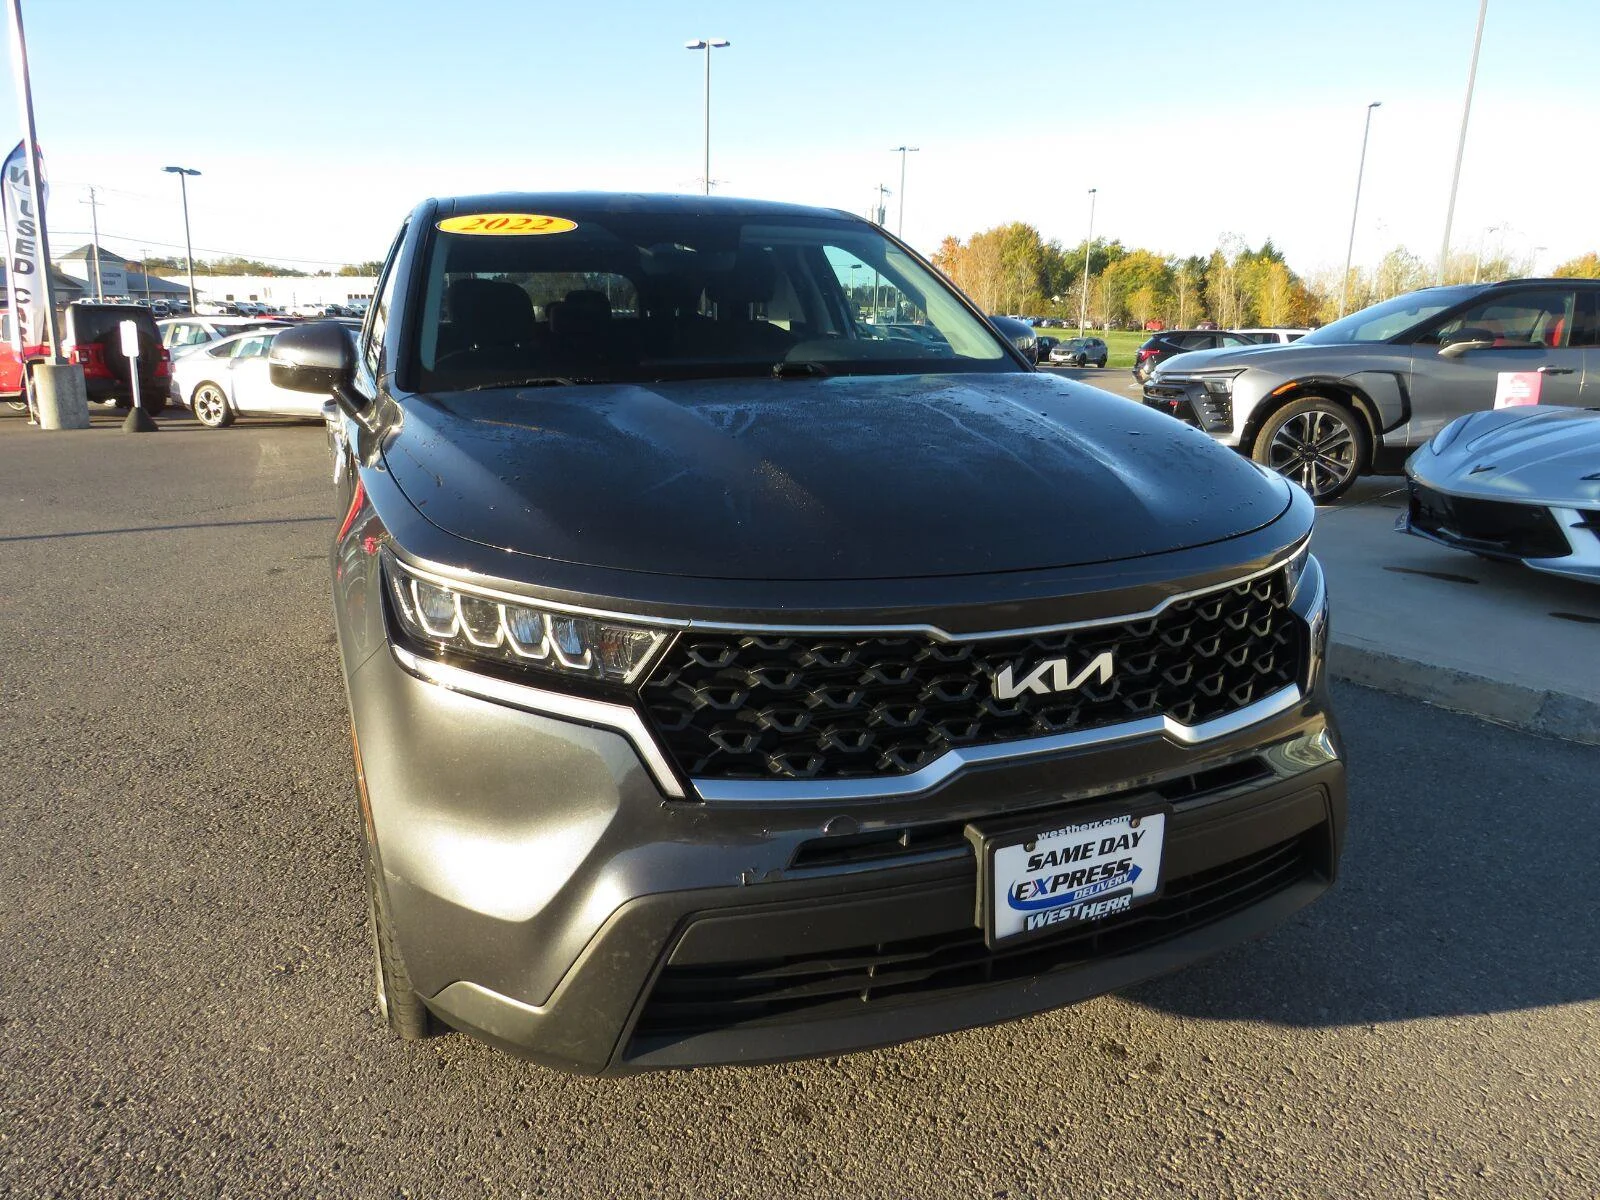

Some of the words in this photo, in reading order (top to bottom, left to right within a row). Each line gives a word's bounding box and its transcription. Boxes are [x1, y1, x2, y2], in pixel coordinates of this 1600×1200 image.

[462, 218, 554, 230] 2022
[997, 652, 1113, 700] KIA
[1026, 842, 1095, 873] SAME
[1098, 830, 1146, 856] DAY
[1014, 858, 1132, 901] EXPRESS
[1073, 874, 1130, 900] DELIVERY
